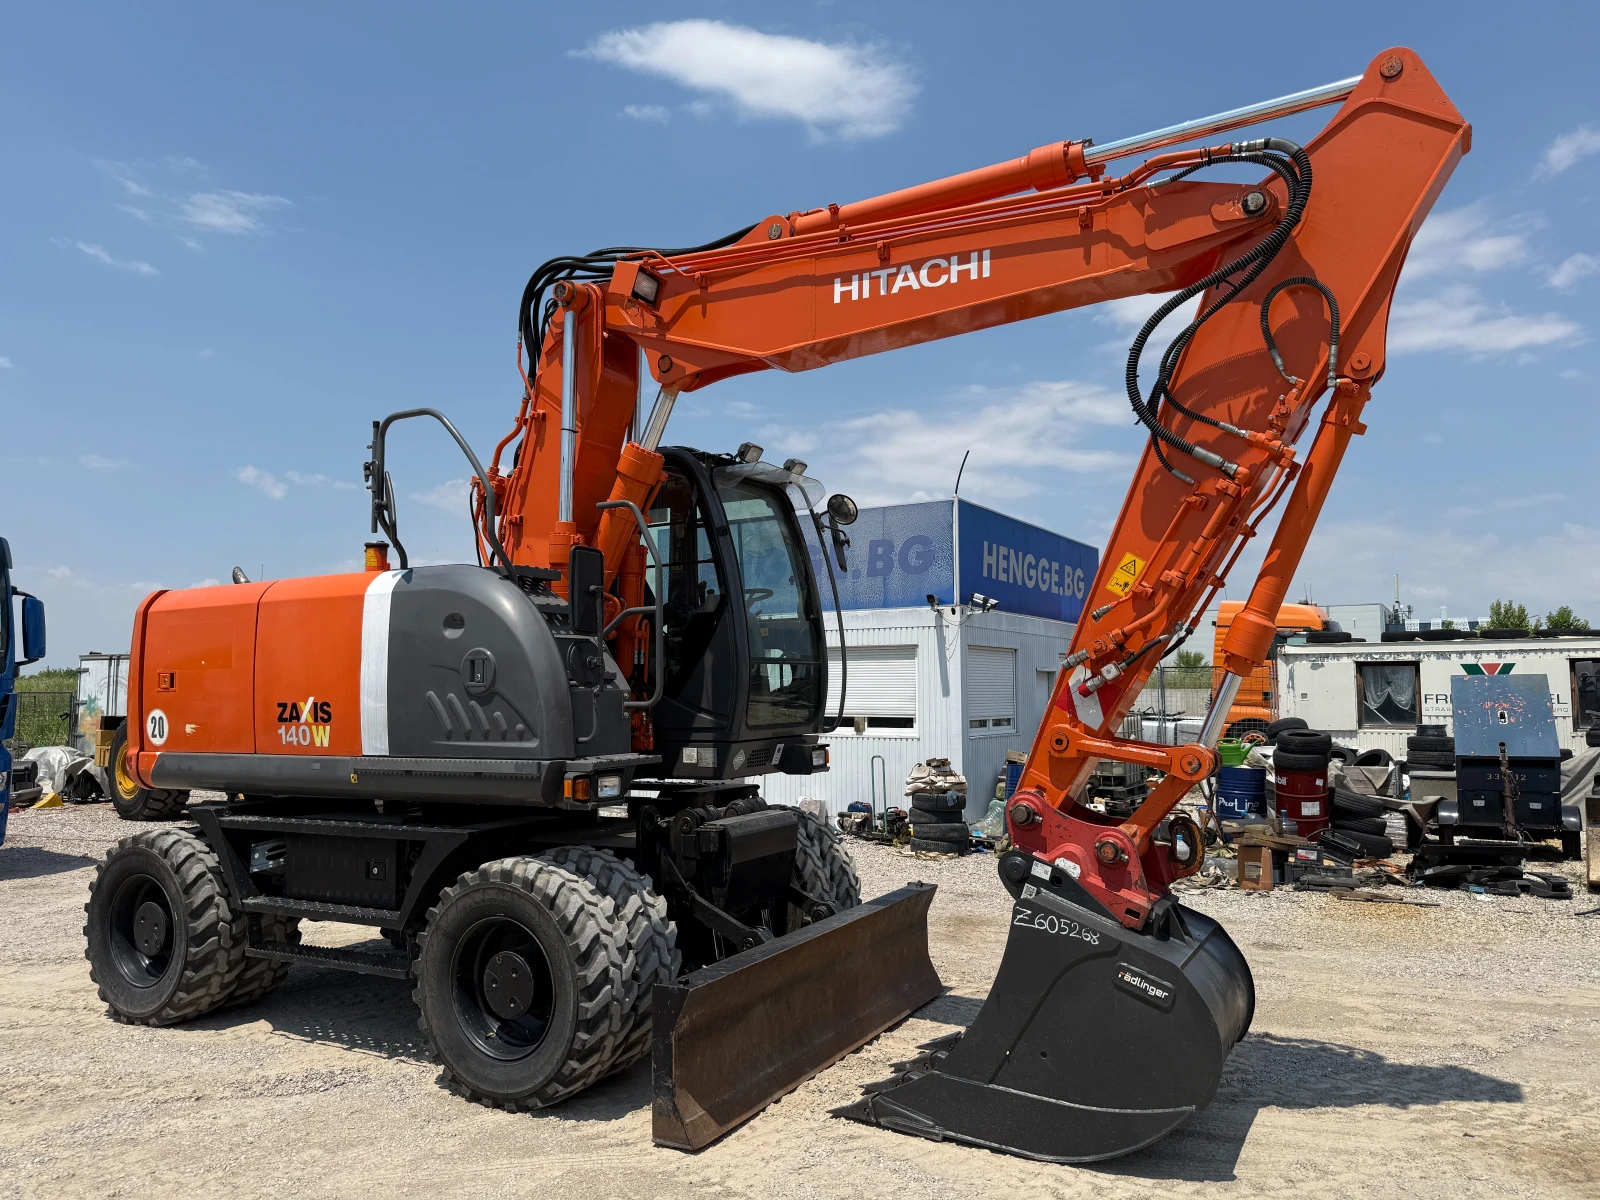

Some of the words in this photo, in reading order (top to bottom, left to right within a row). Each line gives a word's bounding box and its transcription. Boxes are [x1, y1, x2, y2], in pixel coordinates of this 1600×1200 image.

[834, 249, 991, 304] HITACHI
[982, 540, 1085, 600] HENGGE.BG
[277, 697, 332, 723] ZAXIS
[151, 716, 164, 739] 20
[278, 725, 330, 747] 140W
[1014, 906, 1100, 945] Z605268
[1118, 972, 1169, 999] rädlinger
